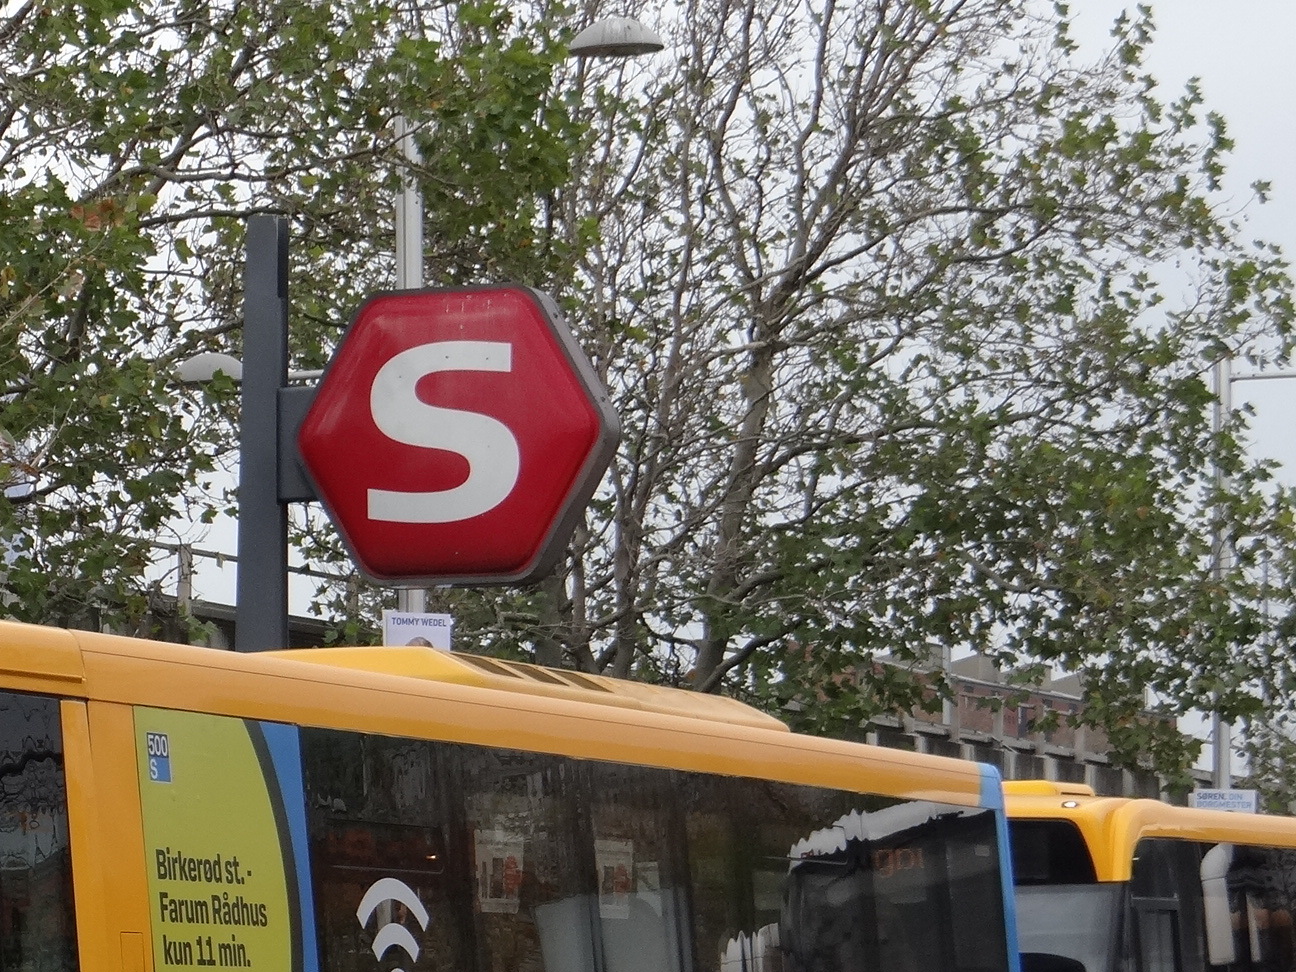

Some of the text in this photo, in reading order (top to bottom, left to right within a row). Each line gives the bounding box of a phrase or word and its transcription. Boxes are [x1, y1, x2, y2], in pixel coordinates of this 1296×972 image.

[367, 341, 520, 524] S
[391, 617, 447, 628] TOMMY WEDEL
[147, 734, 168, 757] 500
[150, 758, 159, 780] S
[155, 847, 223, 884] Birkerød
[225, 856, 245, 885] st.
[159, 891, 268, 927] Farum Rådhus
[162, 934, 251, 967] kun 11 min.
